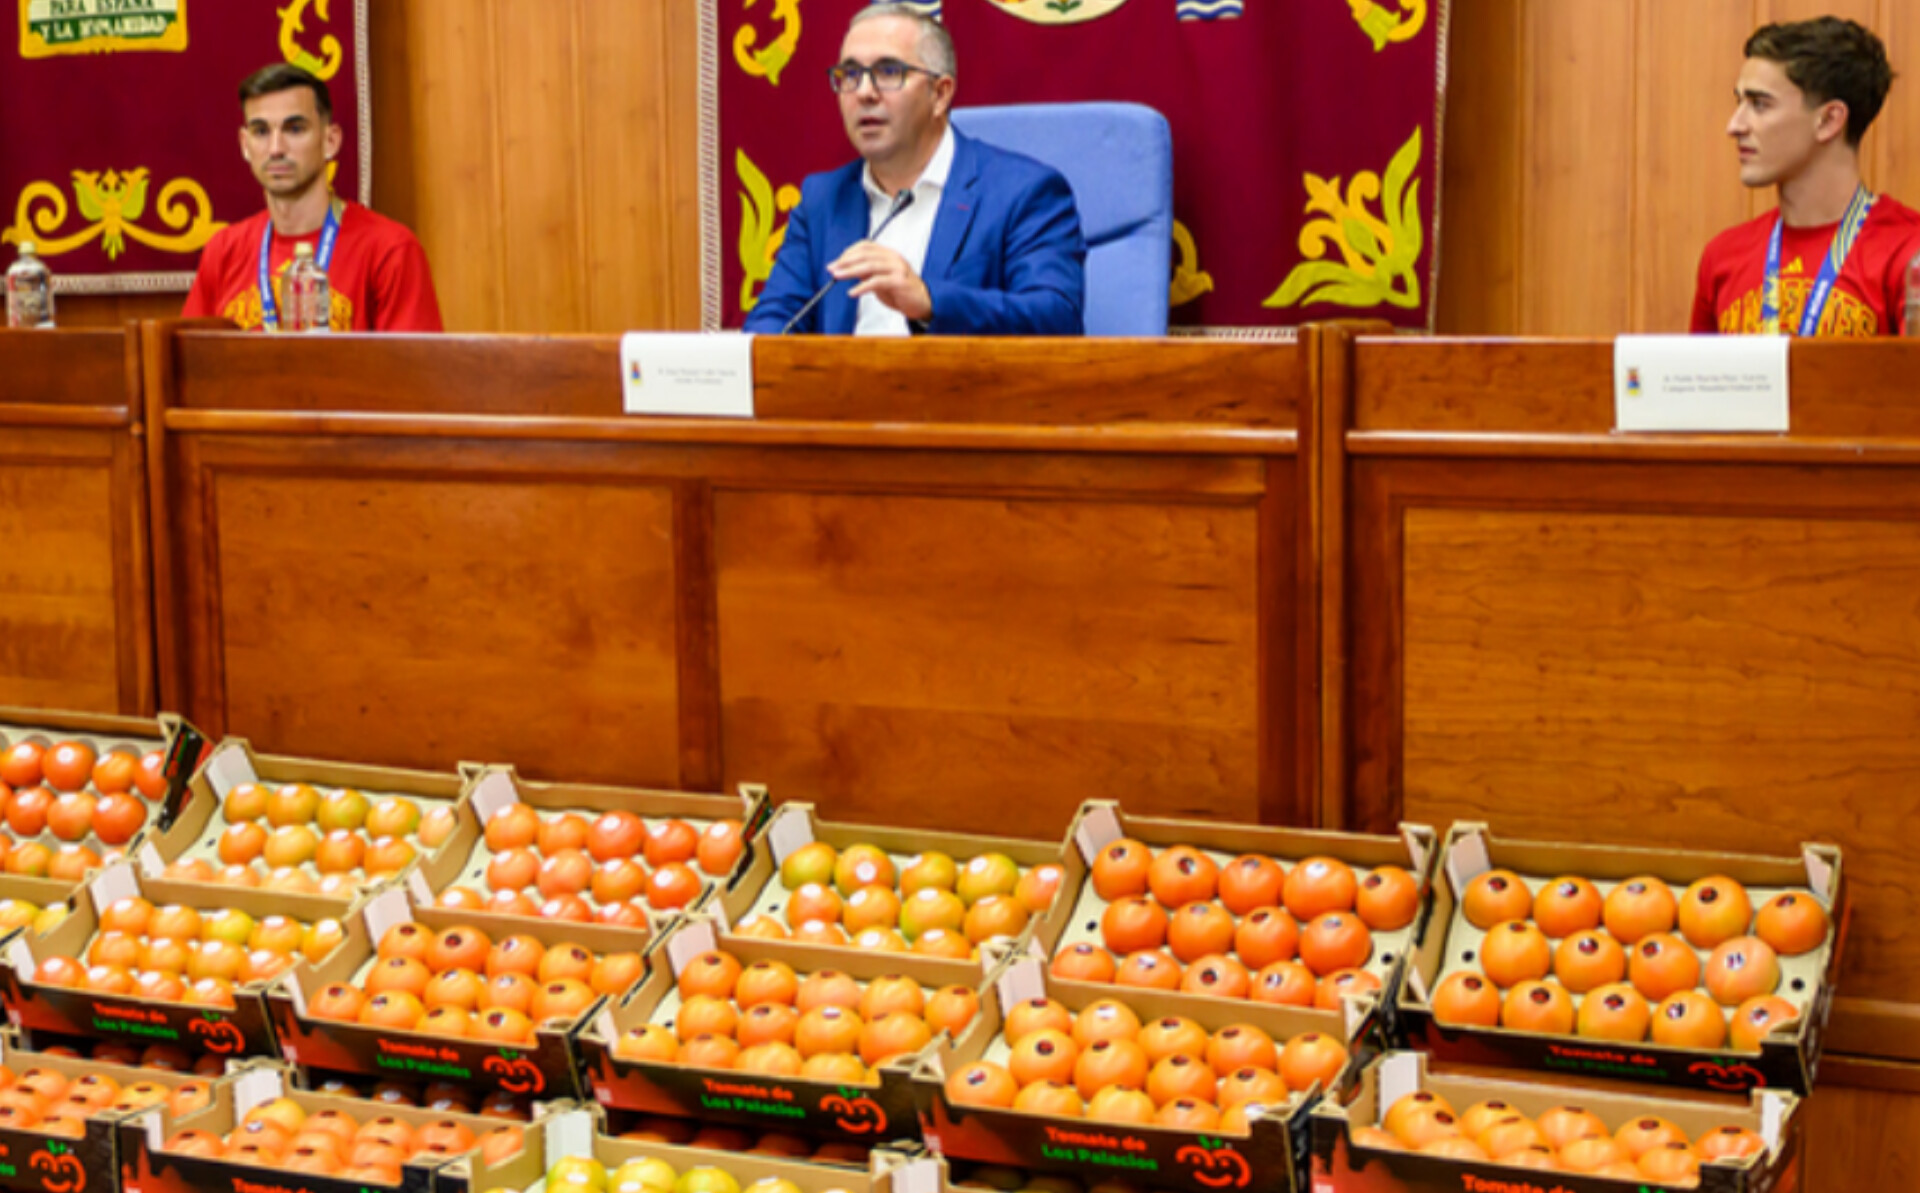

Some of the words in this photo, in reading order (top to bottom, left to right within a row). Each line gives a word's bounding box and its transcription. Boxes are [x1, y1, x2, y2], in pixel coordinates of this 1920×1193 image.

[54, 20, 75, 39] LA
[377, 1039, 437, 1059] Tomate
[438, 1047, 459, 1061] de
[702, 1078, 769, 1098] Tomate
[770, 1086, 795, 1101] de
[701, 1094, 731, 1109] Los
[733, 1097, 806, 1118] Palacios
[1043, 1126, 1119, 1149] Tomate
[1120, 1135, 1146, 1151] de
[1041, 1143, 1075, 1160] Los
[1076, 1148, 1158, 1170] Palacios
